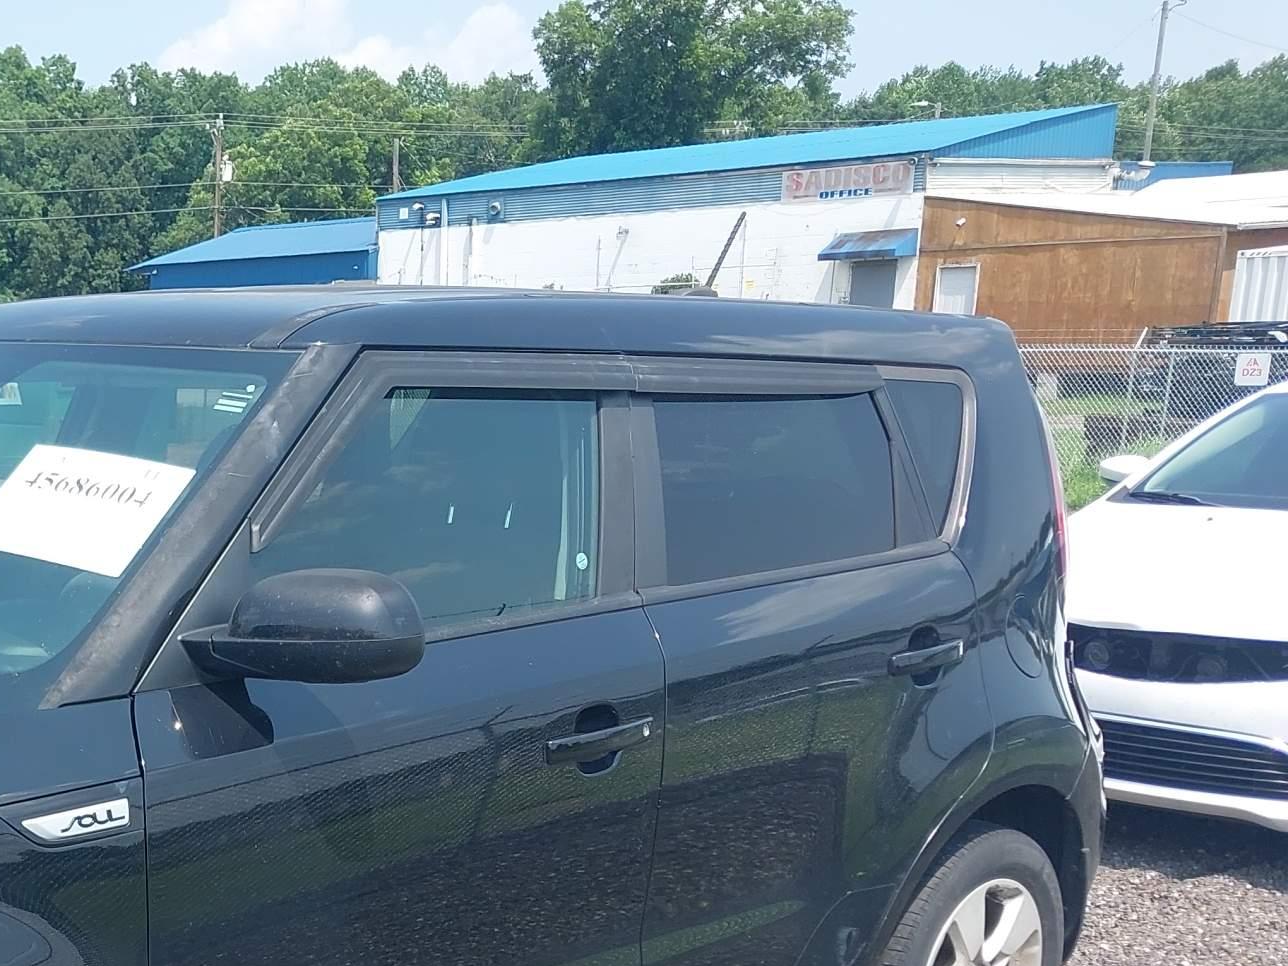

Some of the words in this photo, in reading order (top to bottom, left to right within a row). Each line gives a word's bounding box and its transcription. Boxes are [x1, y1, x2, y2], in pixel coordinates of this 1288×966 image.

[786, 163, 912, 194] SADISCO
[819, 187, 874, 200] OFFICE
[24, 471, 153, 507] 45686004
[60, 809, 126, 833] SOUL
